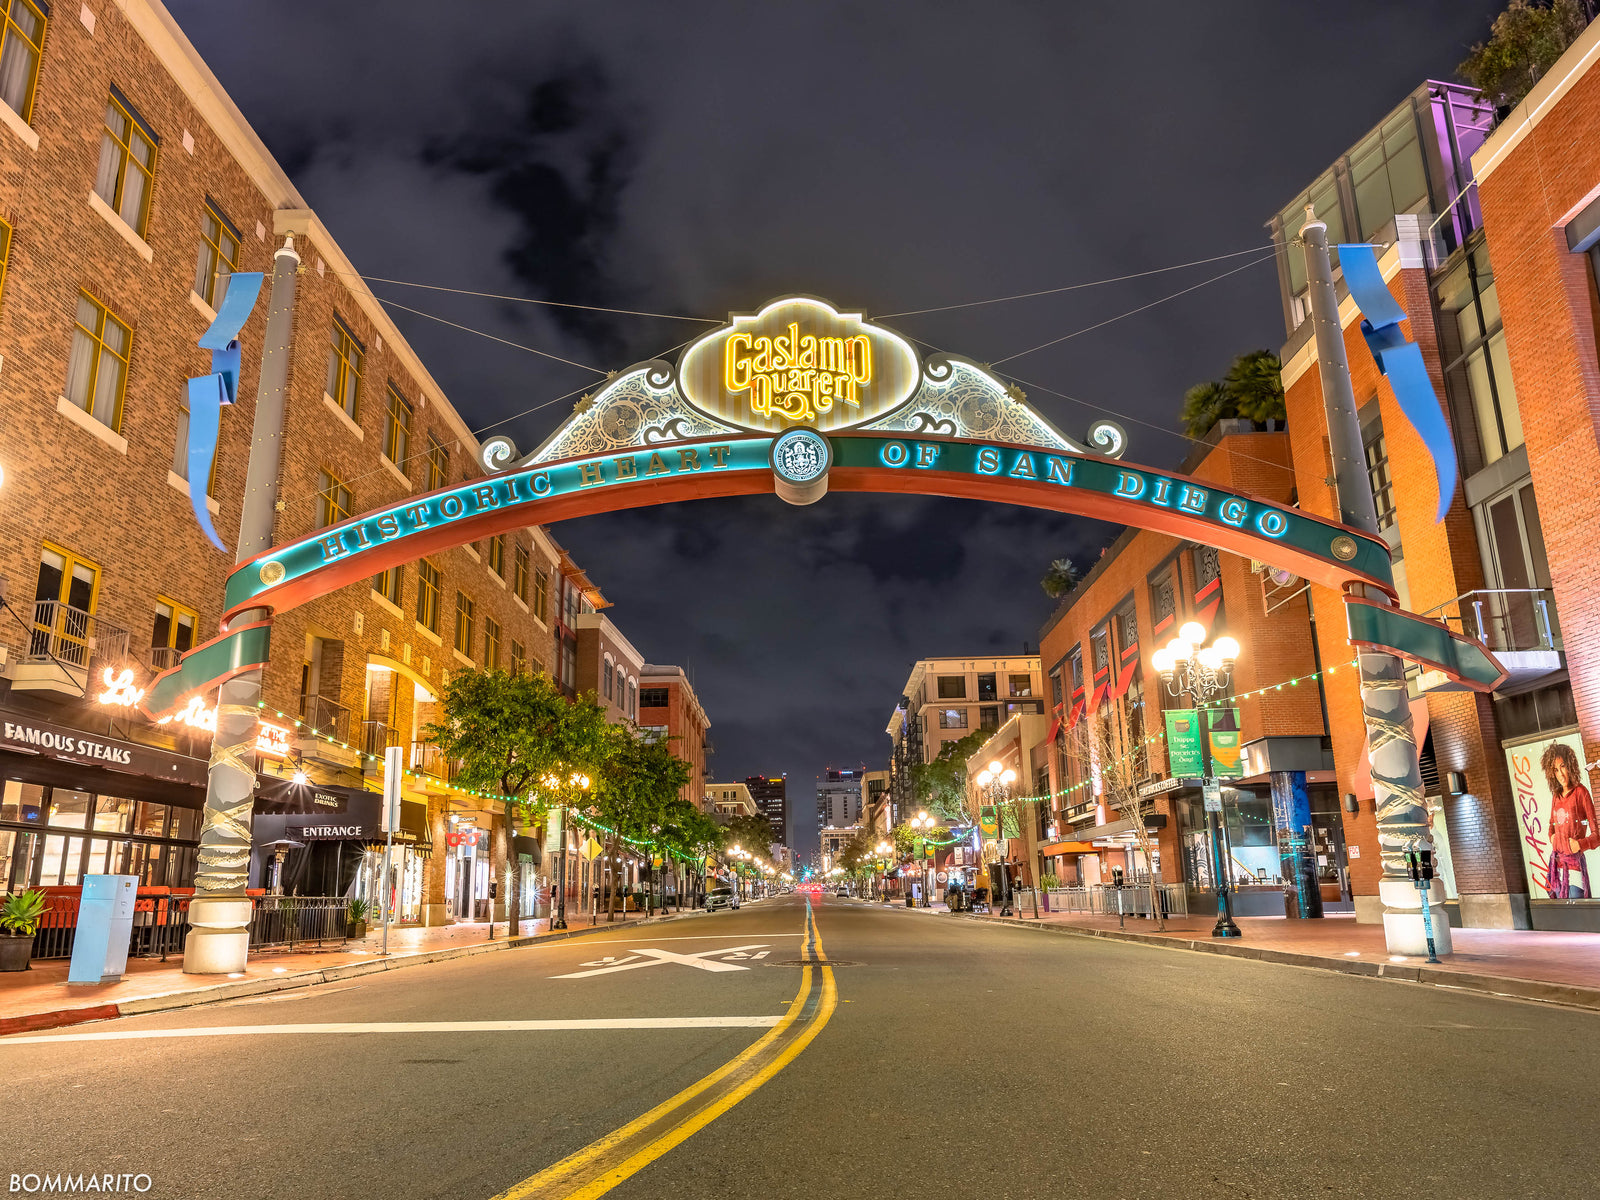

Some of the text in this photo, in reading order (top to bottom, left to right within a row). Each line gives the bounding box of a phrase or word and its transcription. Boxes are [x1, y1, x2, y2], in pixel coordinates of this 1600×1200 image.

[725, 321, 872, 396] Gaslamp
[750, 368, 860, 421] Quarter
[317, 471, 552, 563] HISTORIC
[577, 444, 731, 488] HEART
[882, 441, 940, 467] OF
[977, 448, 1076, 485] SAN
[1116, 470, 1289, 538] DIEGO
[4, 722, 131, 765] FAMOUS STEAKS
[314, 793, 338, 803] EXOTIC
[314, 798, 339, 808] DRINKS
[303, 826, 362, 837] ENTRANCE
[1512, 753, 1552, 892] CLASSICS
